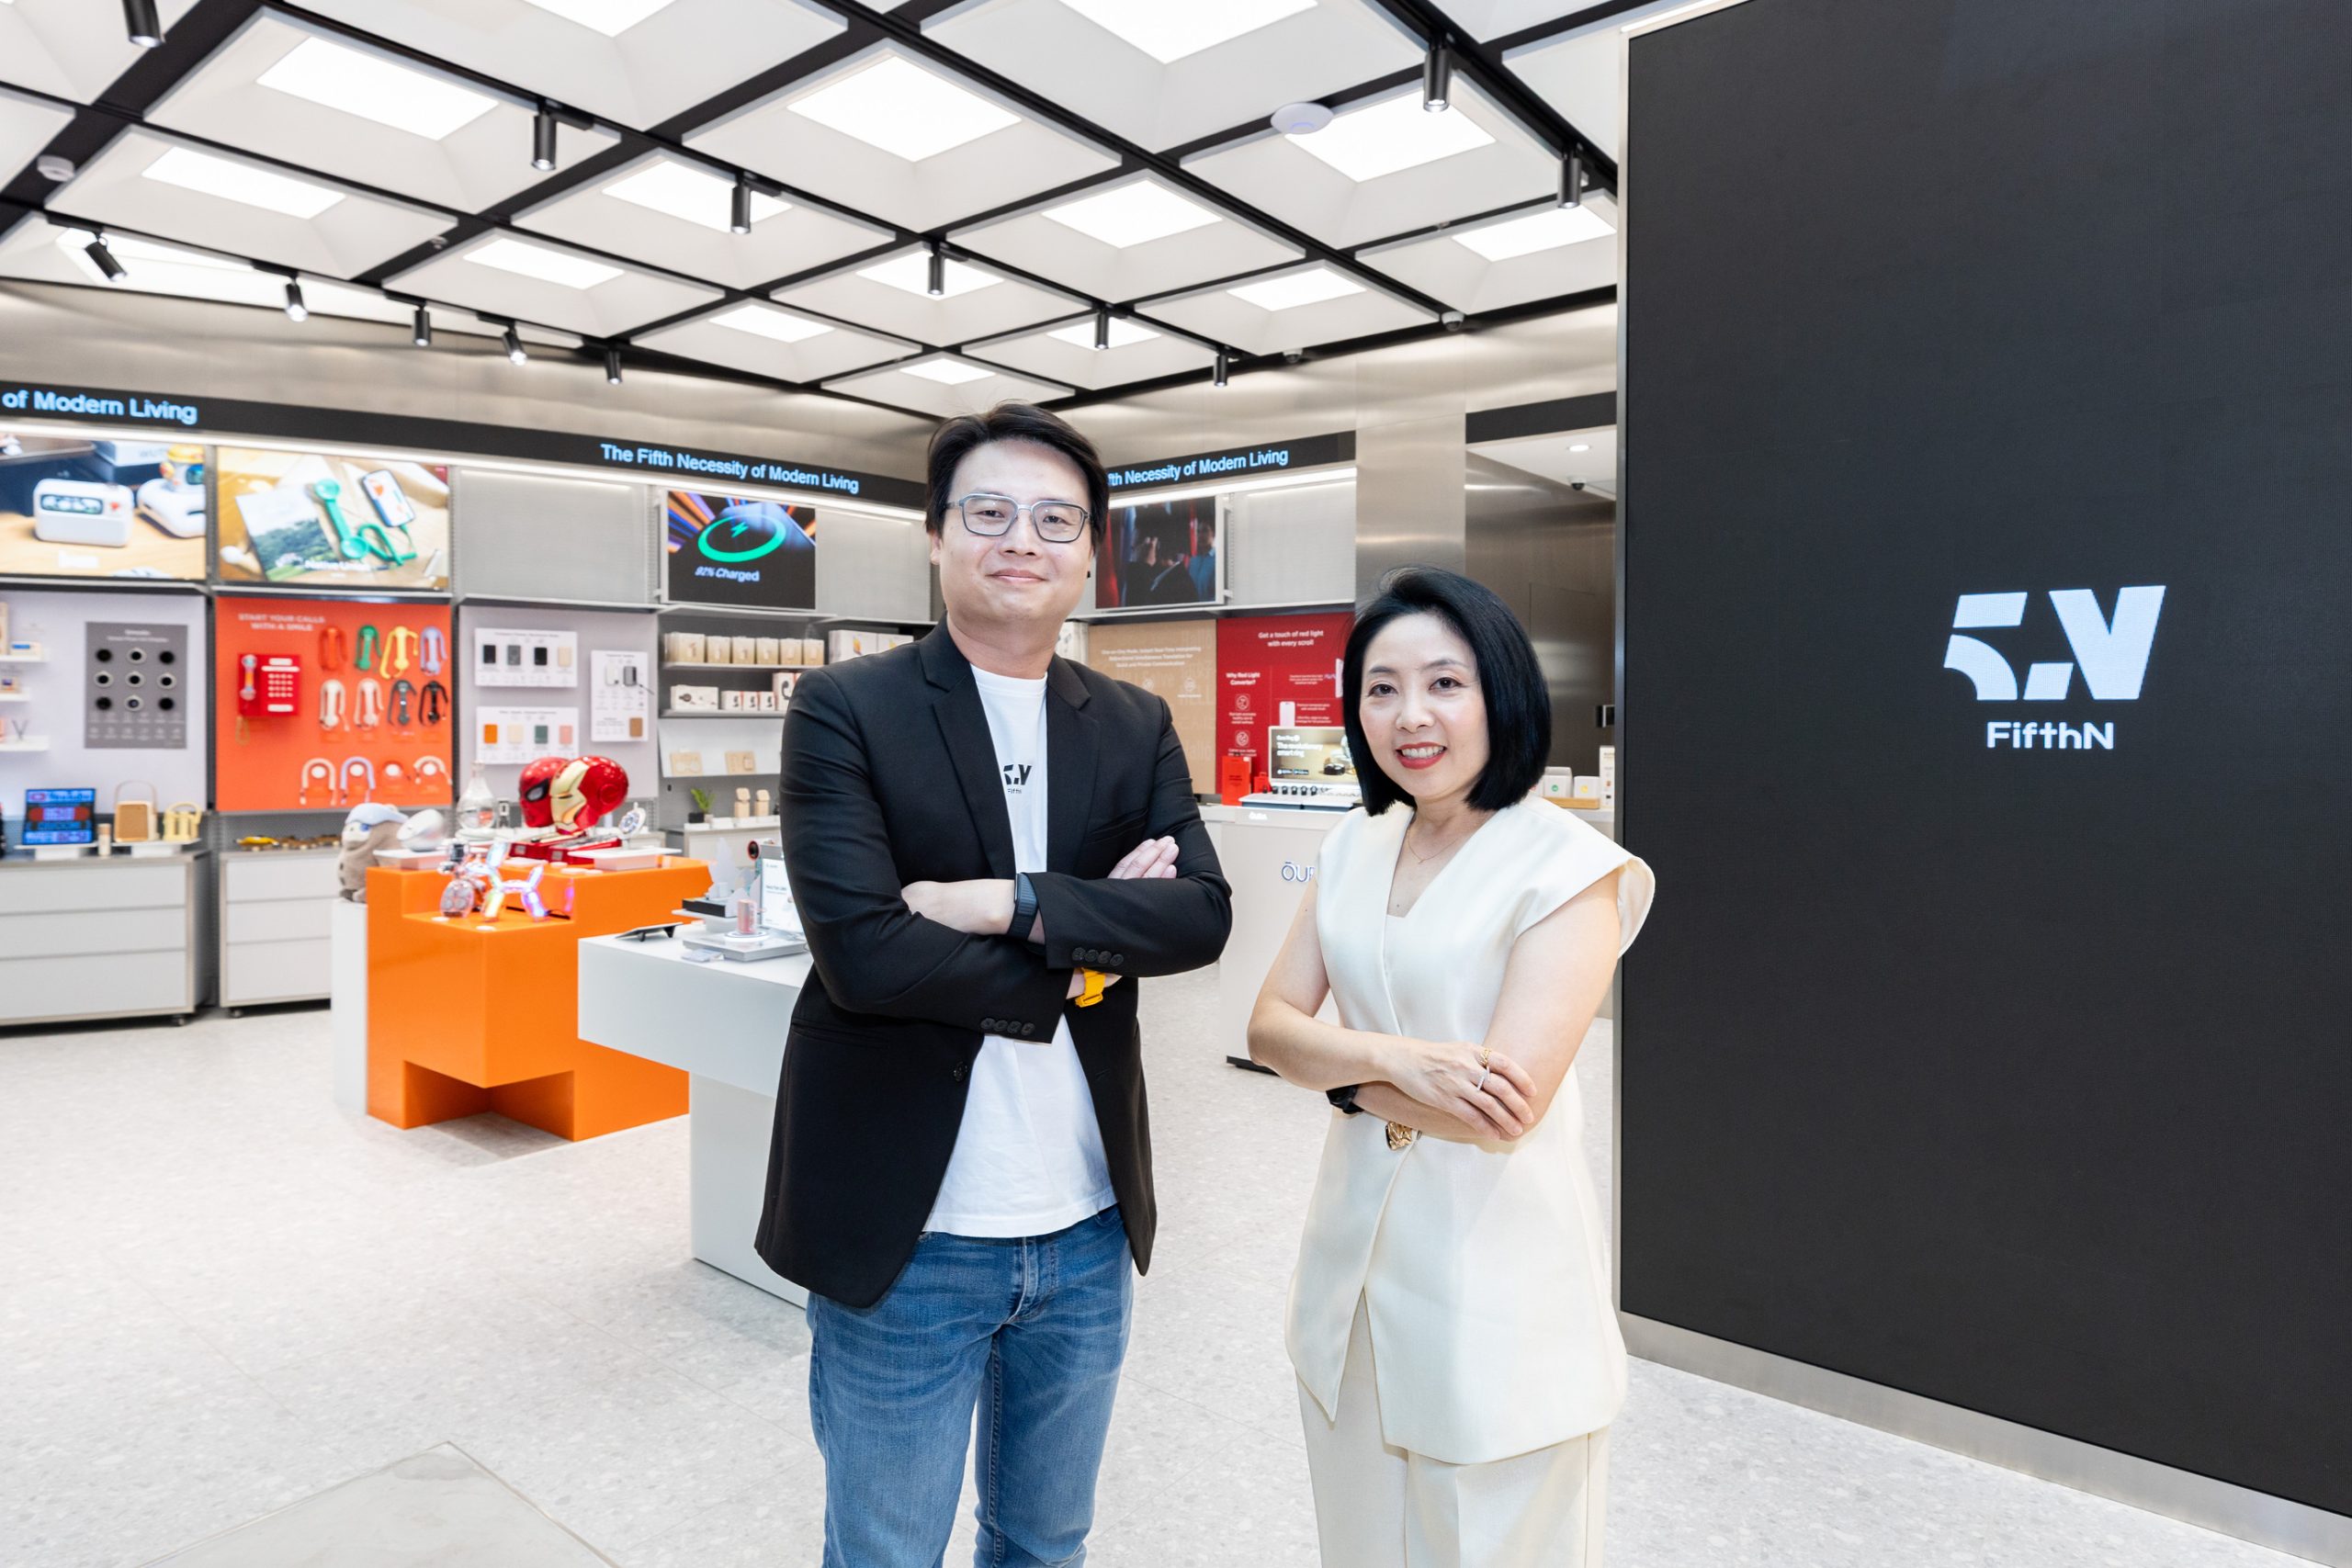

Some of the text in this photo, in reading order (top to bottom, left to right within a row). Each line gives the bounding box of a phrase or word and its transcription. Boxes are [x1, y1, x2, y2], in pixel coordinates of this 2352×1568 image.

[2, 389, 198, 425] of Modern Living
[601, 444, 859, 494] The Fifth Necessity of Modern Living
[1125, 465, 1182, 485] Necessity
[1183, 460, 1197, 476] of
[1199, 456, 1247, 474] Modern
[1250, 449, 1289, 468] Living
[716, 567, 761, 583] Charged
[1310, 629, 1324, 638] light
[1986, 721, 2114, 750] FifthN
